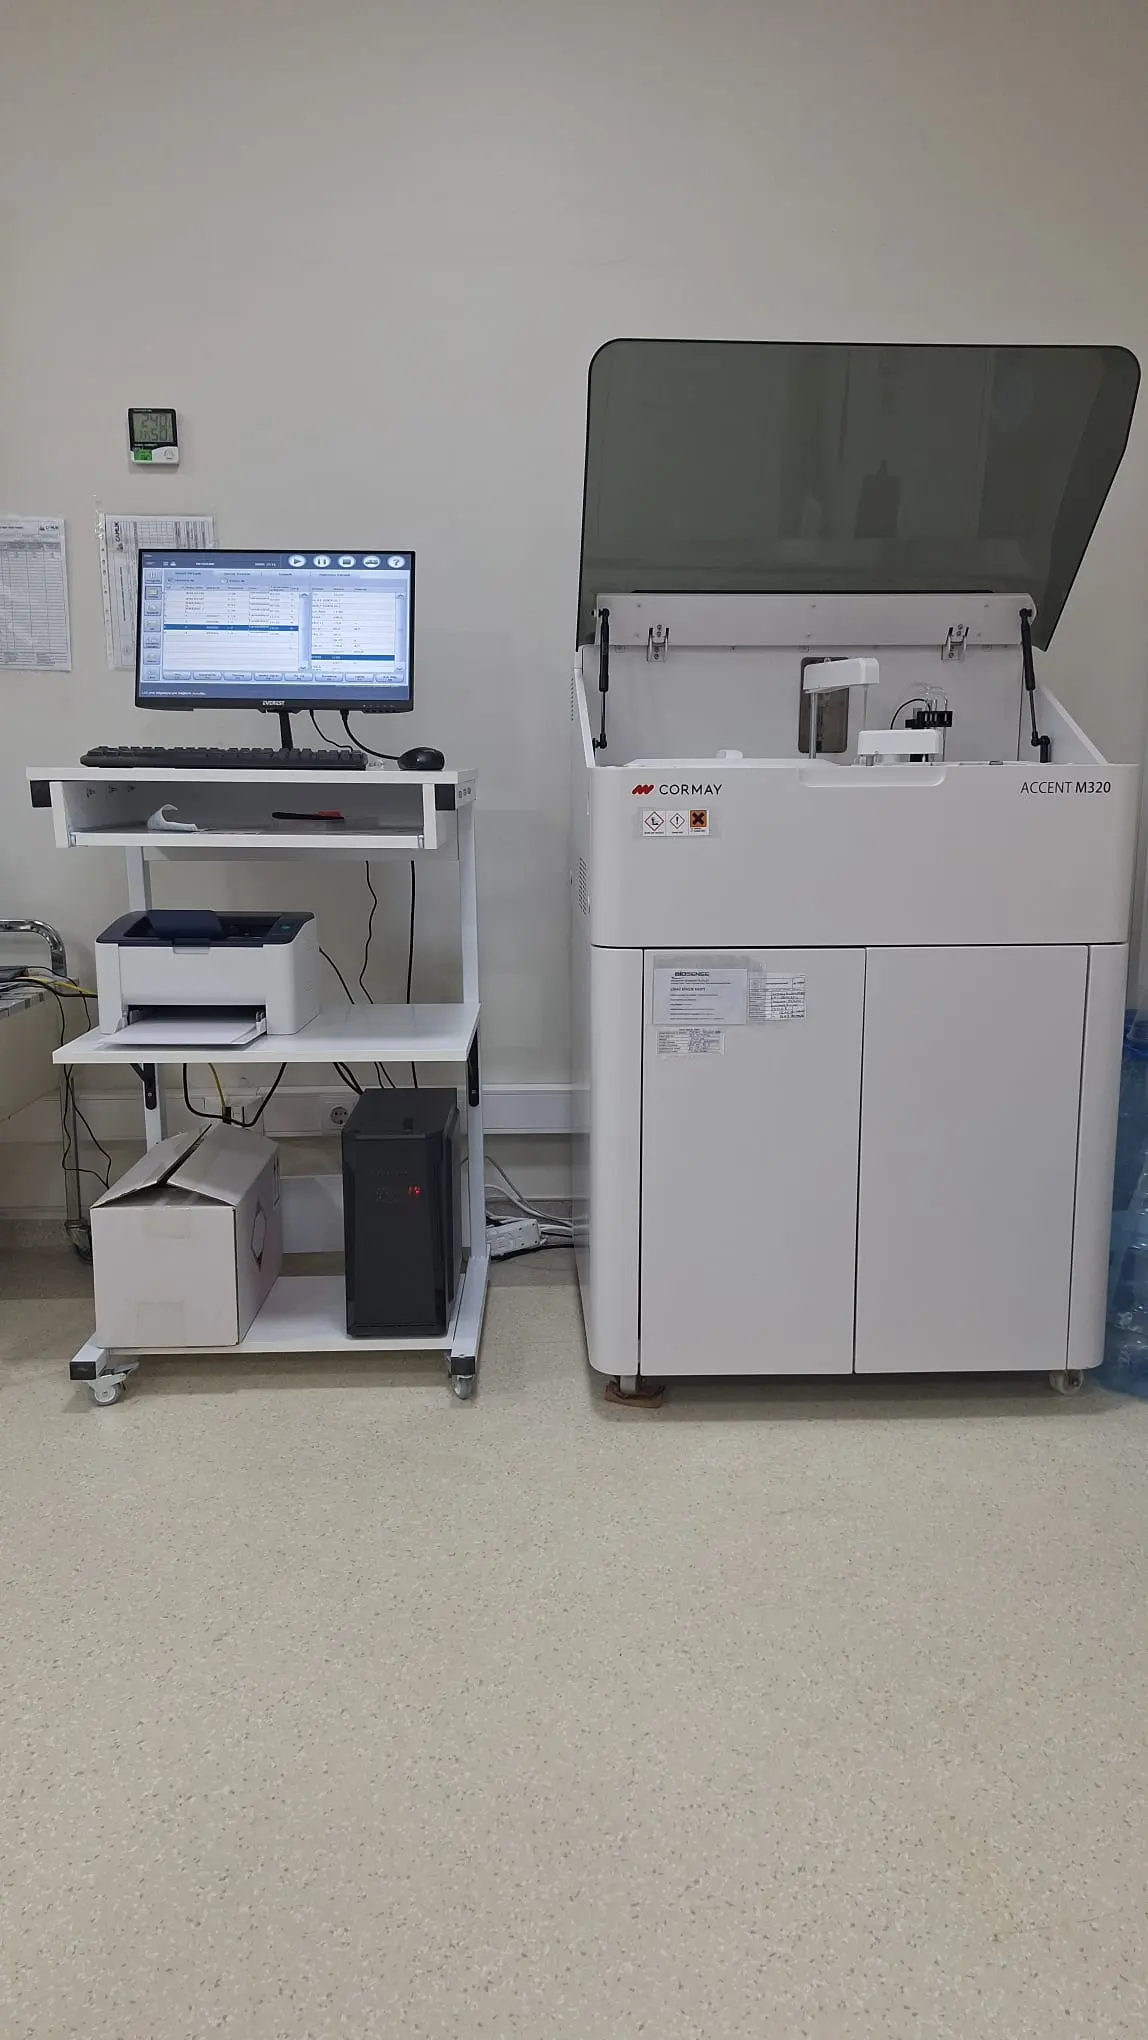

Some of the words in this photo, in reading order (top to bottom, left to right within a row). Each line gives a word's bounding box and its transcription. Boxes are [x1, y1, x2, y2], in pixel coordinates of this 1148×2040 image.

[659, 784, 722, 795] CORMAY
[1020, 781, 1073, 794] ACCENT
[1075, 781, 1111, 794] M320
